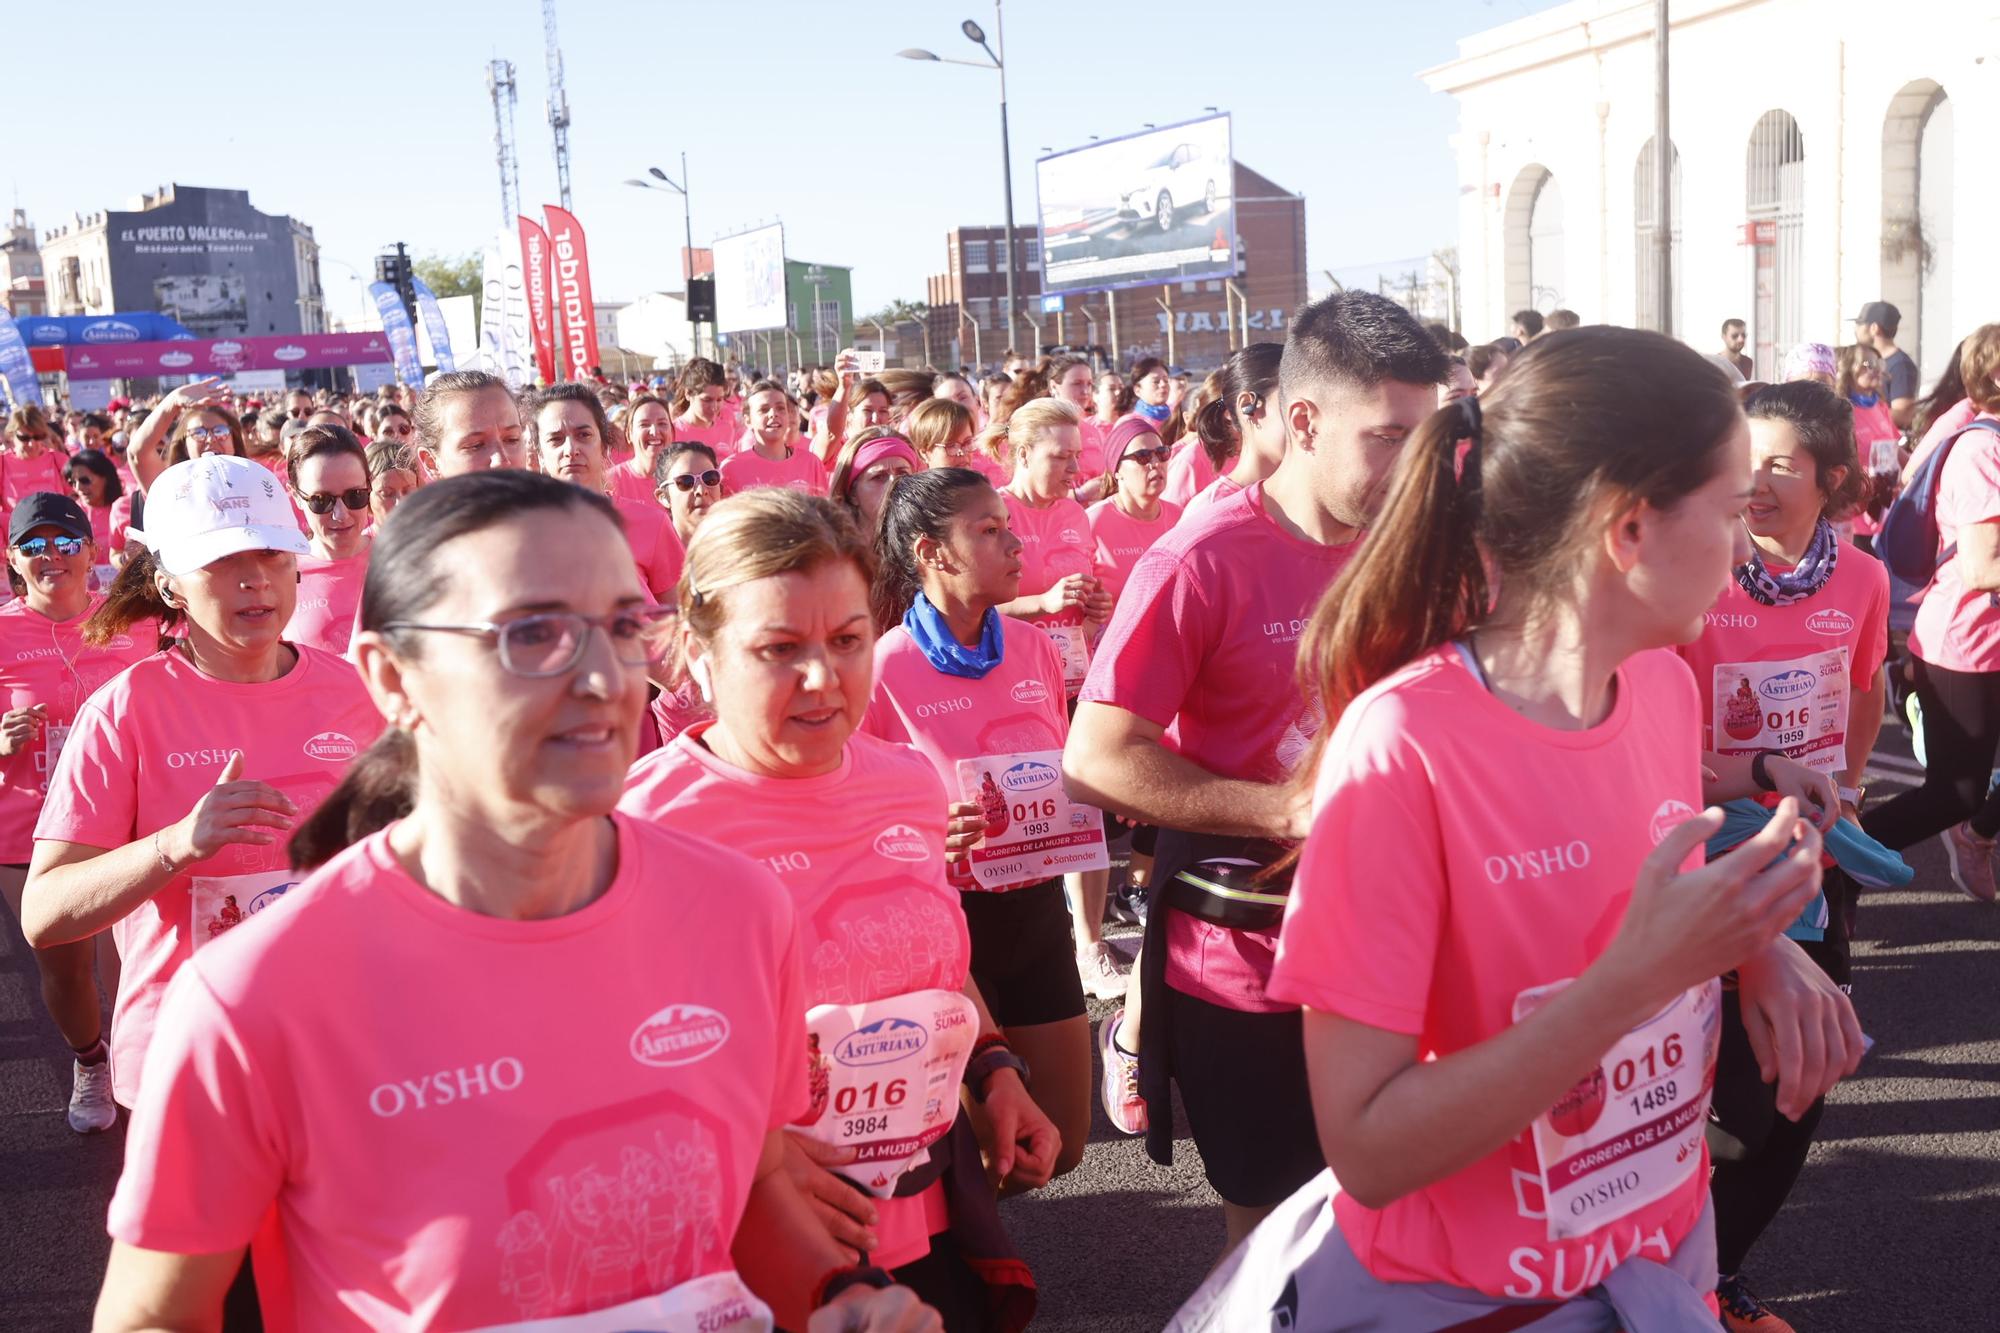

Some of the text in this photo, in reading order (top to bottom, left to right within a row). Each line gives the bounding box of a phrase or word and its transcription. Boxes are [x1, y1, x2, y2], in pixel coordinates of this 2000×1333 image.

[121, 229, 136, 242] EL
[137, 225, 186, 242] PUERTO
[1263, 618, 1312, 636] un po
[1809, 617, 1851, 630] ASTURIANA
[16, 647, 63, 661] OYSHO
[1763, 680, 1812, 696] ASTURIANA
[916, 696, 973, 718] OYSHO
[1766, 706, 1811, 729] 016
[1777, 729, 1804, 745] 1959
[1006, 770, 1056, 788] ASTURIANA
[1012, 798, 1056, 822] 016
[1022, 822, 1050, 837] 1993
[985, 833, 1092, 858] CARRERA DE LA MUJER 2023
[1053, 851, 1097, 866] Santander
[1484, 839, 1592, 885] OYSHO
[983, 862, 1023, 879] OYSHO
[934, 1013, 967, 1032] SUMA
[639, 1024, 724, 1058] ASTURIANA
[840, 1036, 921, 1060] ASTURIANA
[1611, 1032, 1684, 1093] 016
[369, 1055, 524, 1118] OYSHO
[834, 1077, 908, 1115] 016
[1630, 1079, 1678, 1117] 1489
[843, 1114, 888, 1138] 3984
[857, 1146, 875, 1160] LA
[877, 1140, 920, 1158] MUJER
[1568, 1137, 1633, 1176] CARRERA
[1634, 1128, 1655, 1146] DE
[1656, 1119, 1674, 1137] LA
[1569, 1170, 1641, 1217] OYSHO
